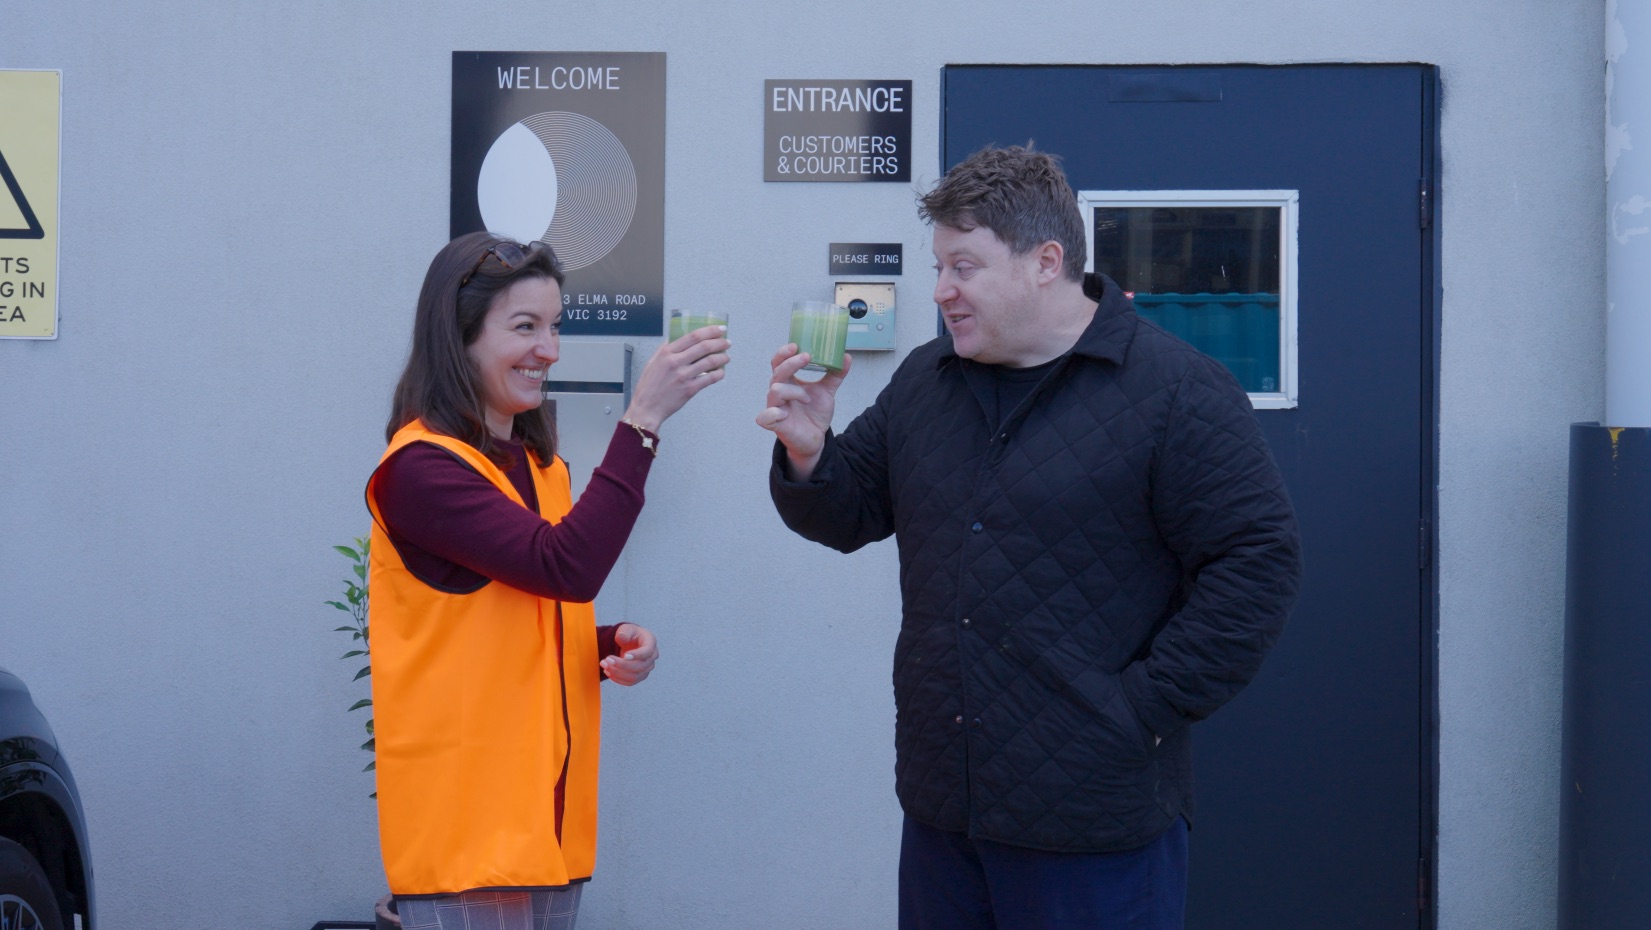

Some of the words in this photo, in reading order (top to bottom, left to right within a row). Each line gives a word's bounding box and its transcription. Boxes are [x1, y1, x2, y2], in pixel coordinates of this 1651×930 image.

[498, 66, 620, 90] WELCOME
[773, 87, 904, 113] ENTRANCE
[779, 135, 897, 155] CUSTOMERS
[777, 156, 791, 174] &
[794, 155, 899, 175] COURIERS
[832, 254, 869, 264] PLEASE
[874, 254, 899, 264] RING
[23, 282, 45, 298] IN
[578, 294, 609, 305] ELMA
[616, 294, 646, 305] ROAD
[567, 309, 590, 320] VIC
[597, 309, 628, 321] 3192
